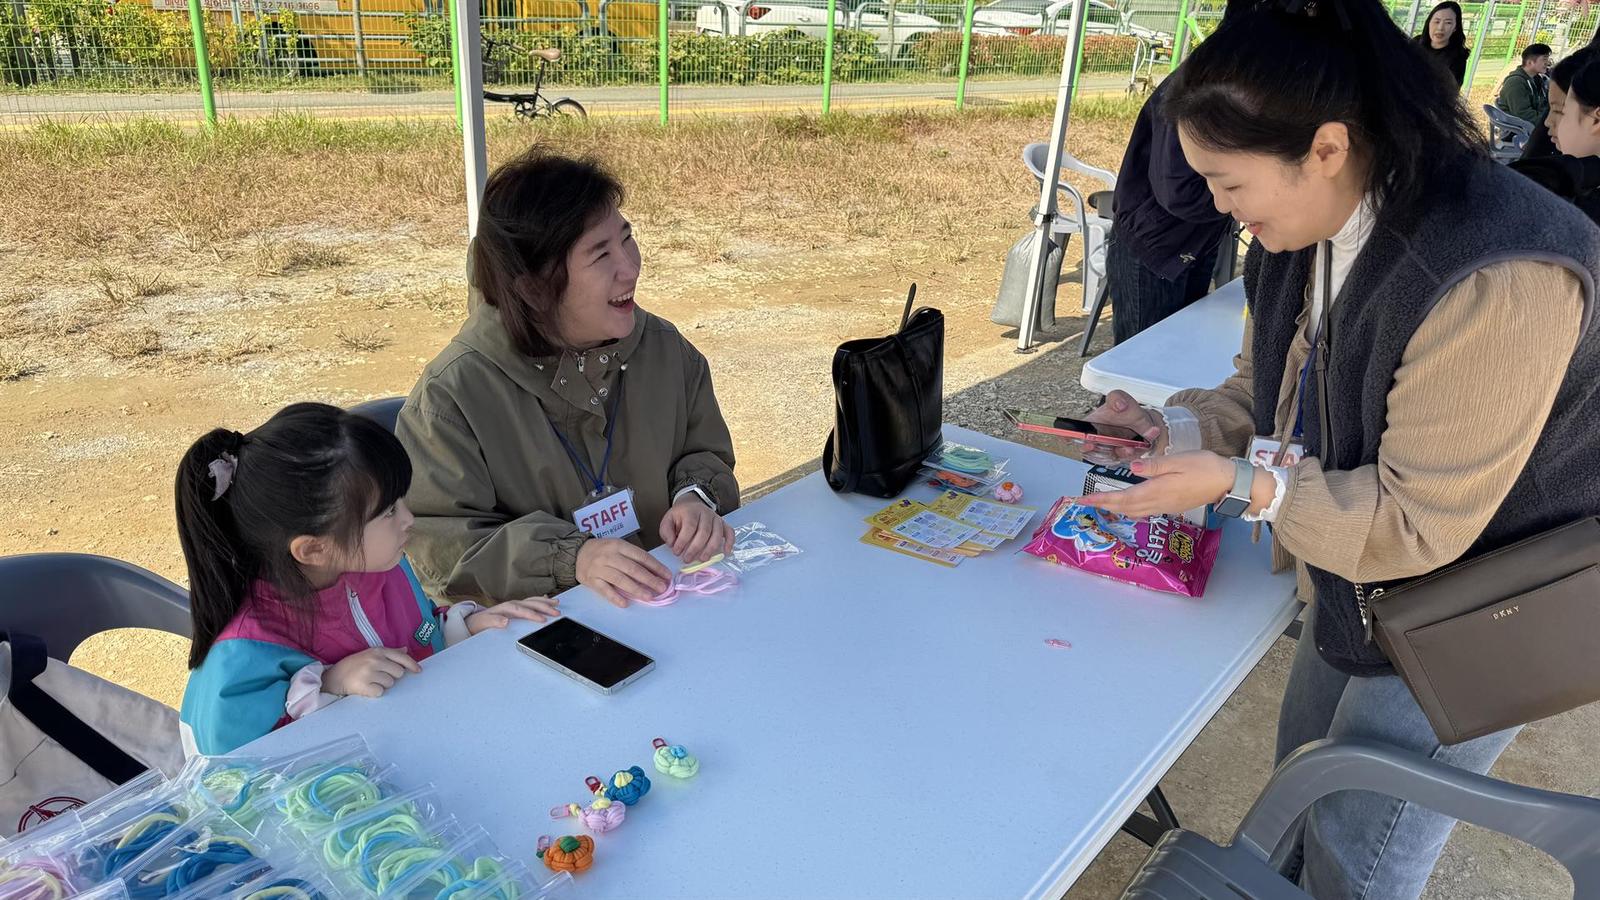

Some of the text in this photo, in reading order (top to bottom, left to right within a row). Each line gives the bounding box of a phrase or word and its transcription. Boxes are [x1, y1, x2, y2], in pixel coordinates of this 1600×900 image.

[1253, 449, 1297, 468] STA
[581, 501, 629, 533] STAFF
[1492, 605, 1520, 620] DKNY
